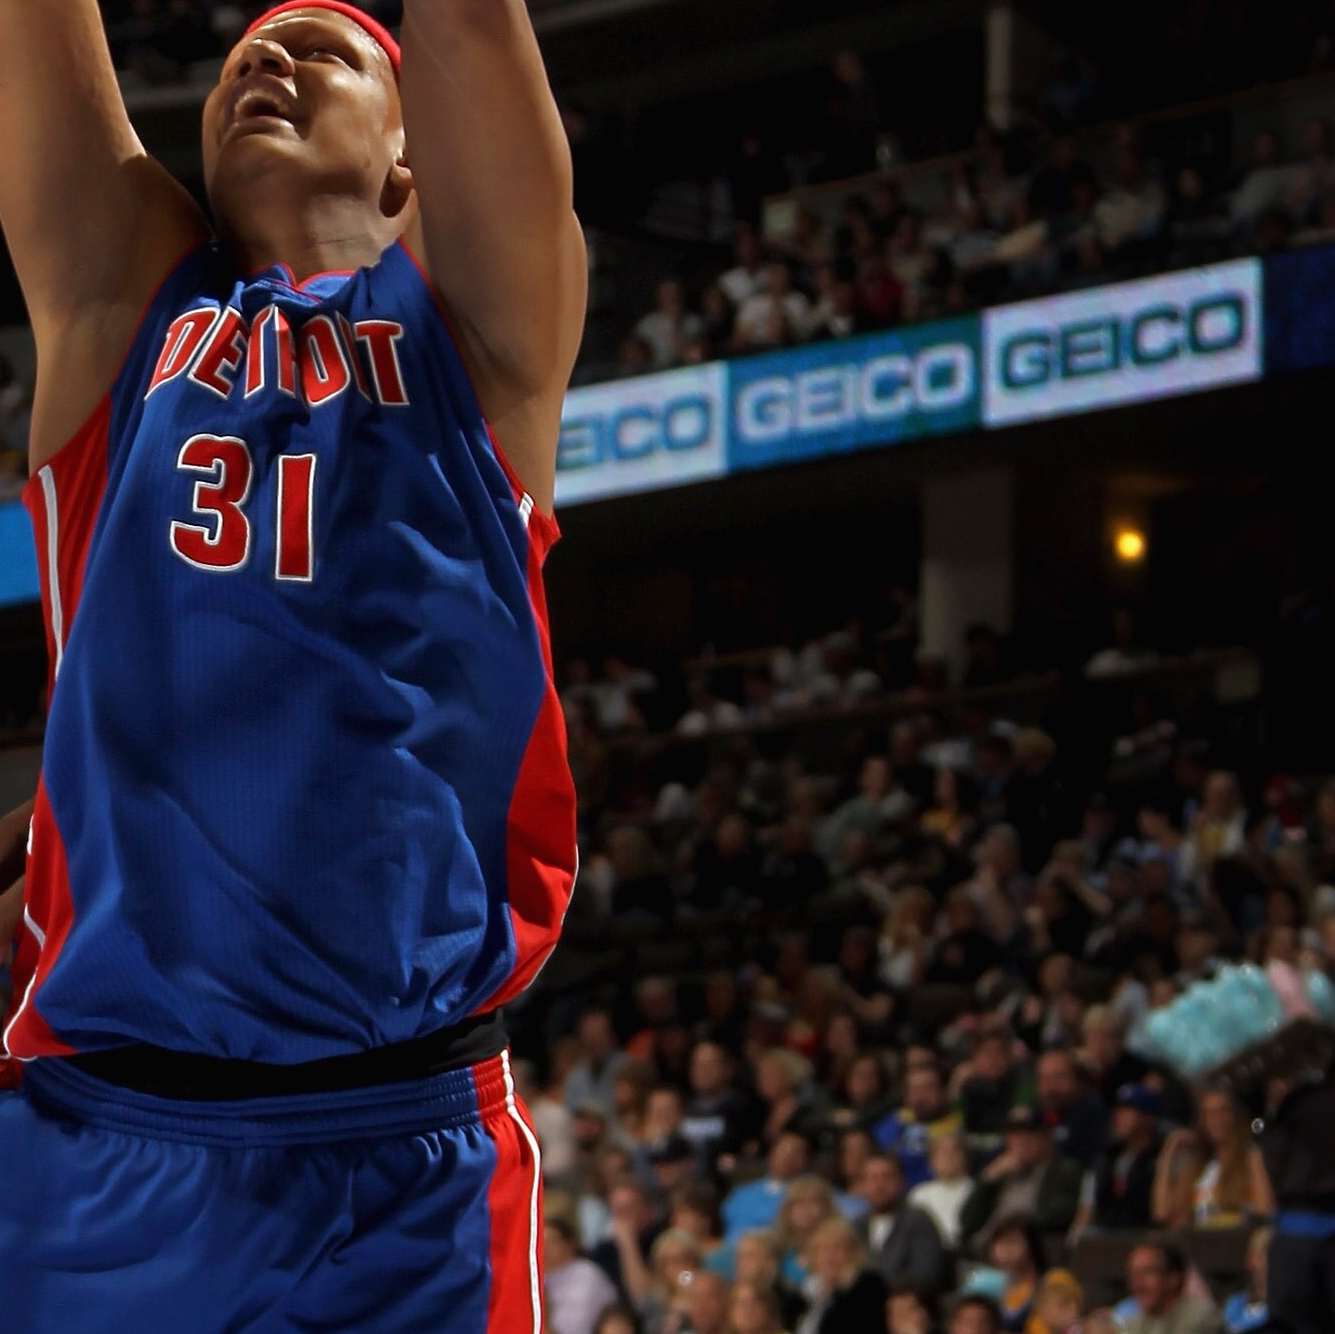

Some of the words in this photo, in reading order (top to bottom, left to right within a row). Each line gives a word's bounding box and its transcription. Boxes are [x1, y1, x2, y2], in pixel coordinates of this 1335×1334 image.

[1000, 291, 1244, 391] GEICO
[557, 394, 713, 469] EICO
[732, 342, 975, 443] GEICO
[169, 432, 317, 583] 31
